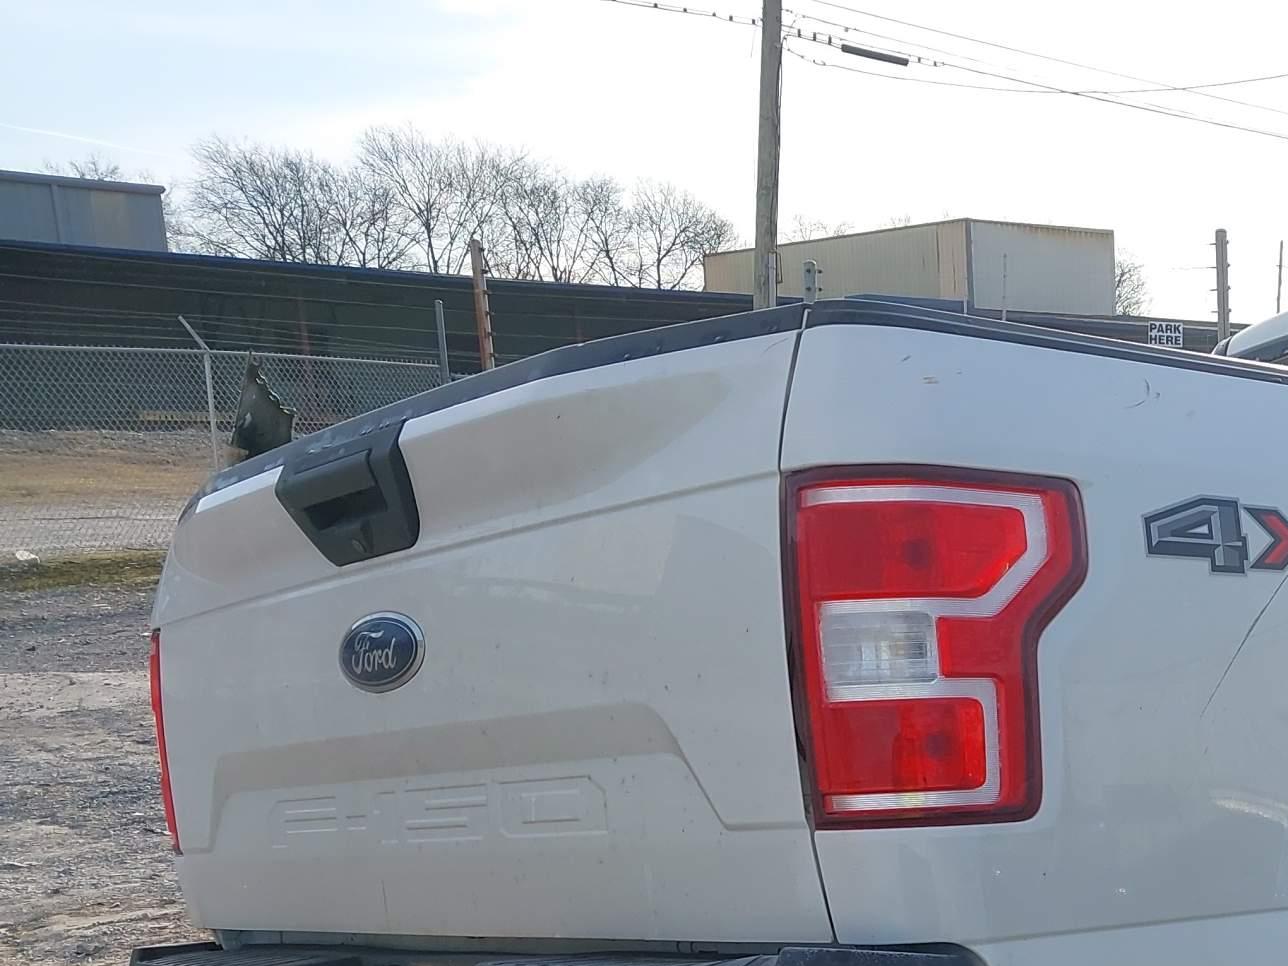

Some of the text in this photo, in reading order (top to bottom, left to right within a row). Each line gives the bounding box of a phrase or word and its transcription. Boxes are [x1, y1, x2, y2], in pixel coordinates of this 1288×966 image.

[1149, 322, 1182, 335] PARK
[1149, 334, 1182, 346] HERE
[351, 629, 398, 675] Ford
[268, 774, 610, 849] F-150
